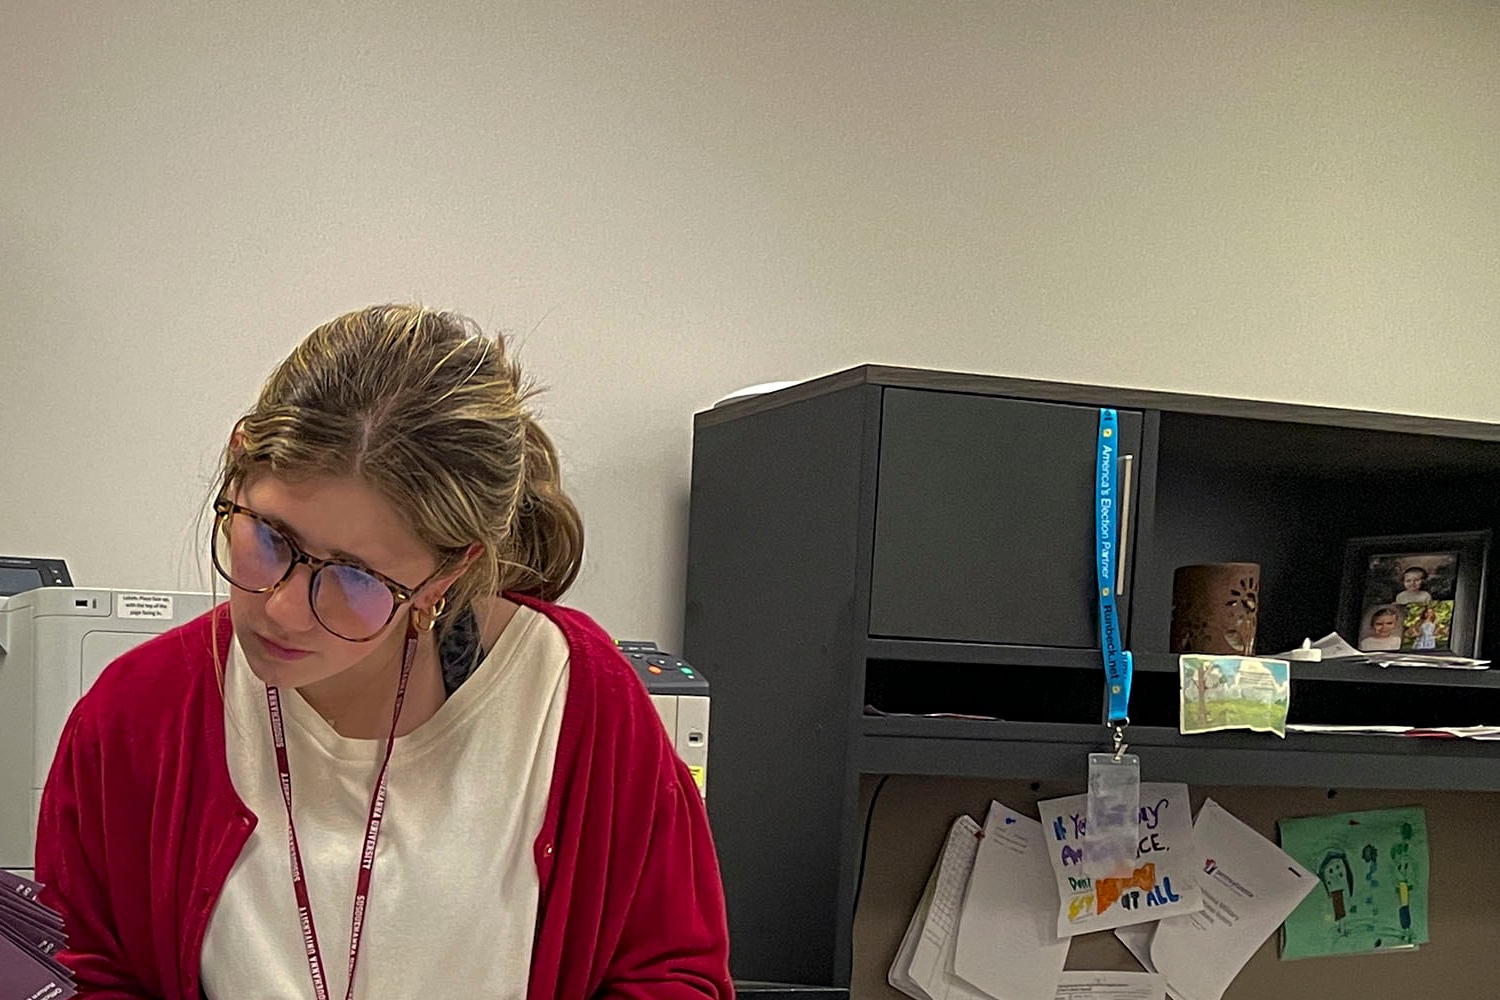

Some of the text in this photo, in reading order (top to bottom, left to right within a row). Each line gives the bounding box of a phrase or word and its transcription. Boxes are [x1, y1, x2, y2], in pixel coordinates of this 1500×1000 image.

[1100, 444, 1113, 580] America's Election Partner
[1104, 605, 1120, 680] Runbeck.net
